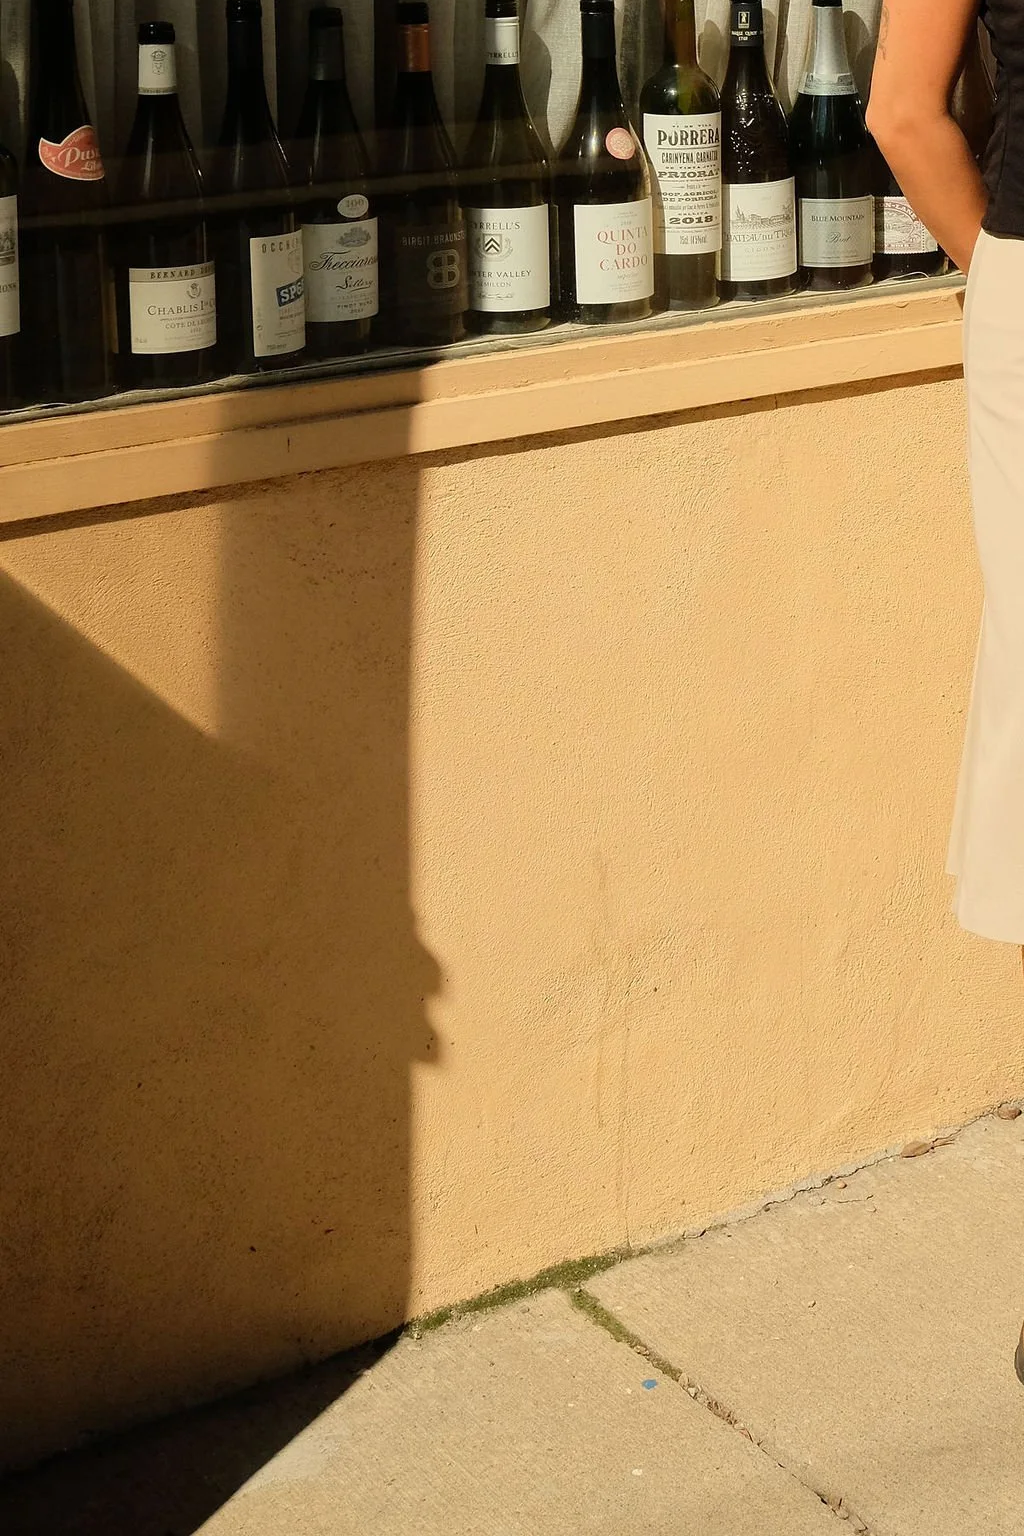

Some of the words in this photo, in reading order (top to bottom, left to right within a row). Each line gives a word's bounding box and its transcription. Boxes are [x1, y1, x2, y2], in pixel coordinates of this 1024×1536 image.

[657, 127, 720, 146] PORRERA
[669, 215, 713, 225] 2018
[597, 226, 649, 245] QUINTA
[616, 243, 637, 256] DO
[600, 255, 648, 272] CARDO
[497, 270, 532, 278] VALLEY
[147, 303, 198, 316] CHABLIS
